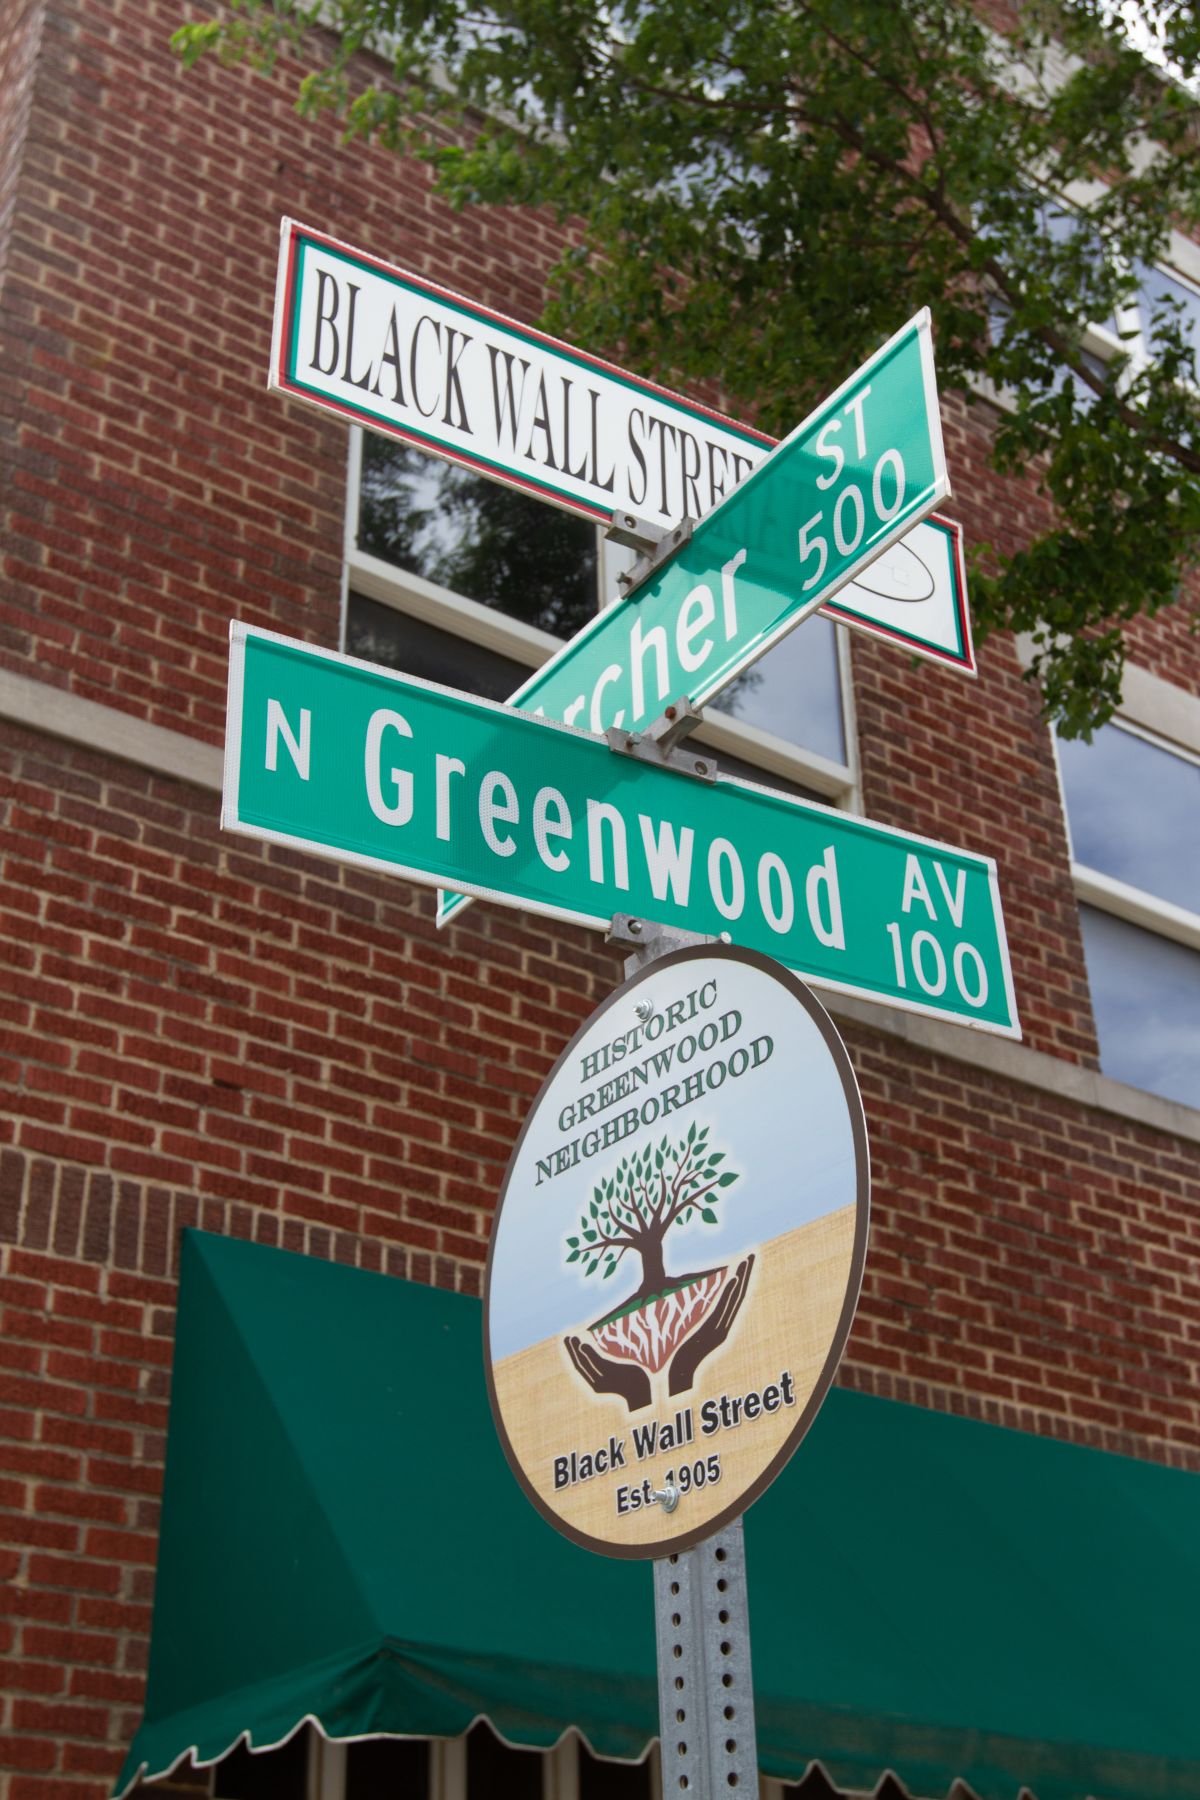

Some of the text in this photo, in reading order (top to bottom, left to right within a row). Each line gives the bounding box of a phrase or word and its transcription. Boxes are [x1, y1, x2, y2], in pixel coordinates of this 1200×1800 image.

[309, 268, 474, 435] BLACK
[485, 343, 616, 493] WALL
[815, 384, 872, 490] ST
[798, 448, 906, 591] 500
[264, 698, 967, 951] N Greenwood AV
[886, 921, 989, 1008] 100
[557, 1009, 742, 1133] GREENWOOD
[580, 979, 719, 1083] HISTORIC
[535, 1035, 774, 1187] NEIGHBORHOOD
[554, 1372, 794, 1489] Black Wall Street
